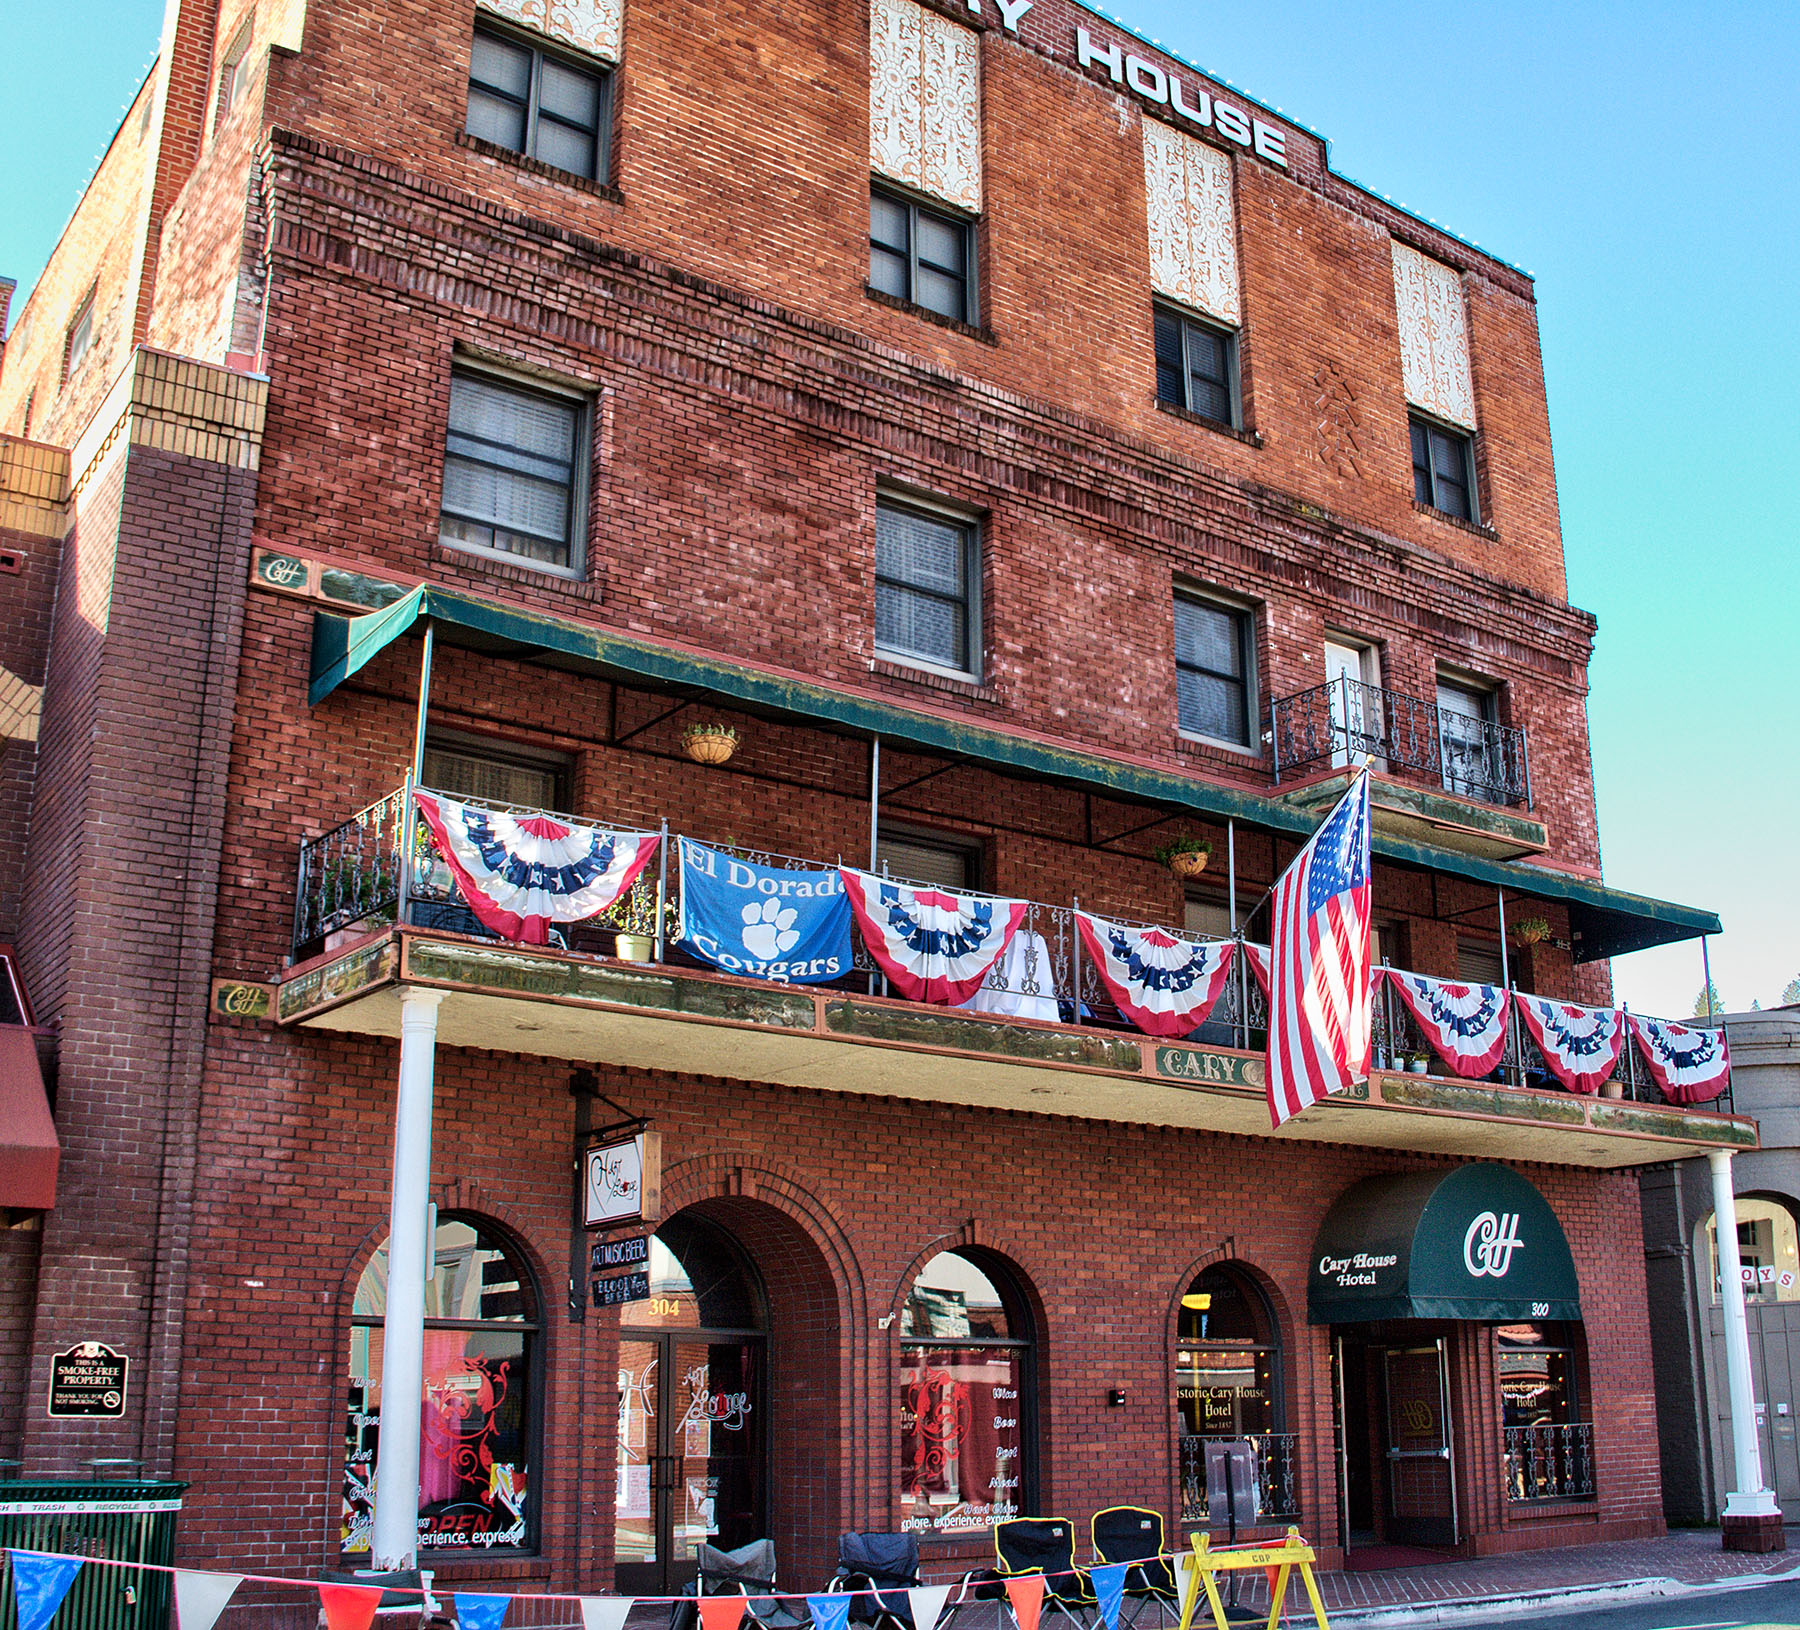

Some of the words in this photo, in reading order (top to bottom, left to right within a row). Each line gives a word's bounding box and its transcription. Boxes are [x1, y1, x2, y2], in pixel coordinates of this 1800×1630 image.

[1076, 26, 1288, 168] HOUSE
[684, 846, 718, 878] El
[691, 934, 840, 984] Cougars
[1162, 1049, 1237, 1082] CARY
[1319, 1255, 1352, 1276] Cary
[1353, 1252, 1398, 1269] House
[1336, 1270, 1377, 1287] Hotel
[1741, 1268, 1792, 1286] OYS
[648, 1298, 680, 1316] 304
[1531, 1302, 1549, 1317] 300
[57, 1366, 120, 1376] SMOKE-FREE
[1176, 1385, 1208, 1399] istoric
[1209, 1385, 1234, 1402] Cary
[1236, 1385, 1265, 1399] House
[1204, 1402, 1232, 1418] Hotel
[993, 1416, 1017, 1430] Beer
[32, 1503, 66, 1511] TRASH
[418, 1513, 494, 1537] OPEN
[901, 1515, 932, 1530] xplore.
[934, 1514, 985, 1530] experience.
[416, 1530, 469, 1545] perience.
[1252, 1555, 1271, 1563] COP
